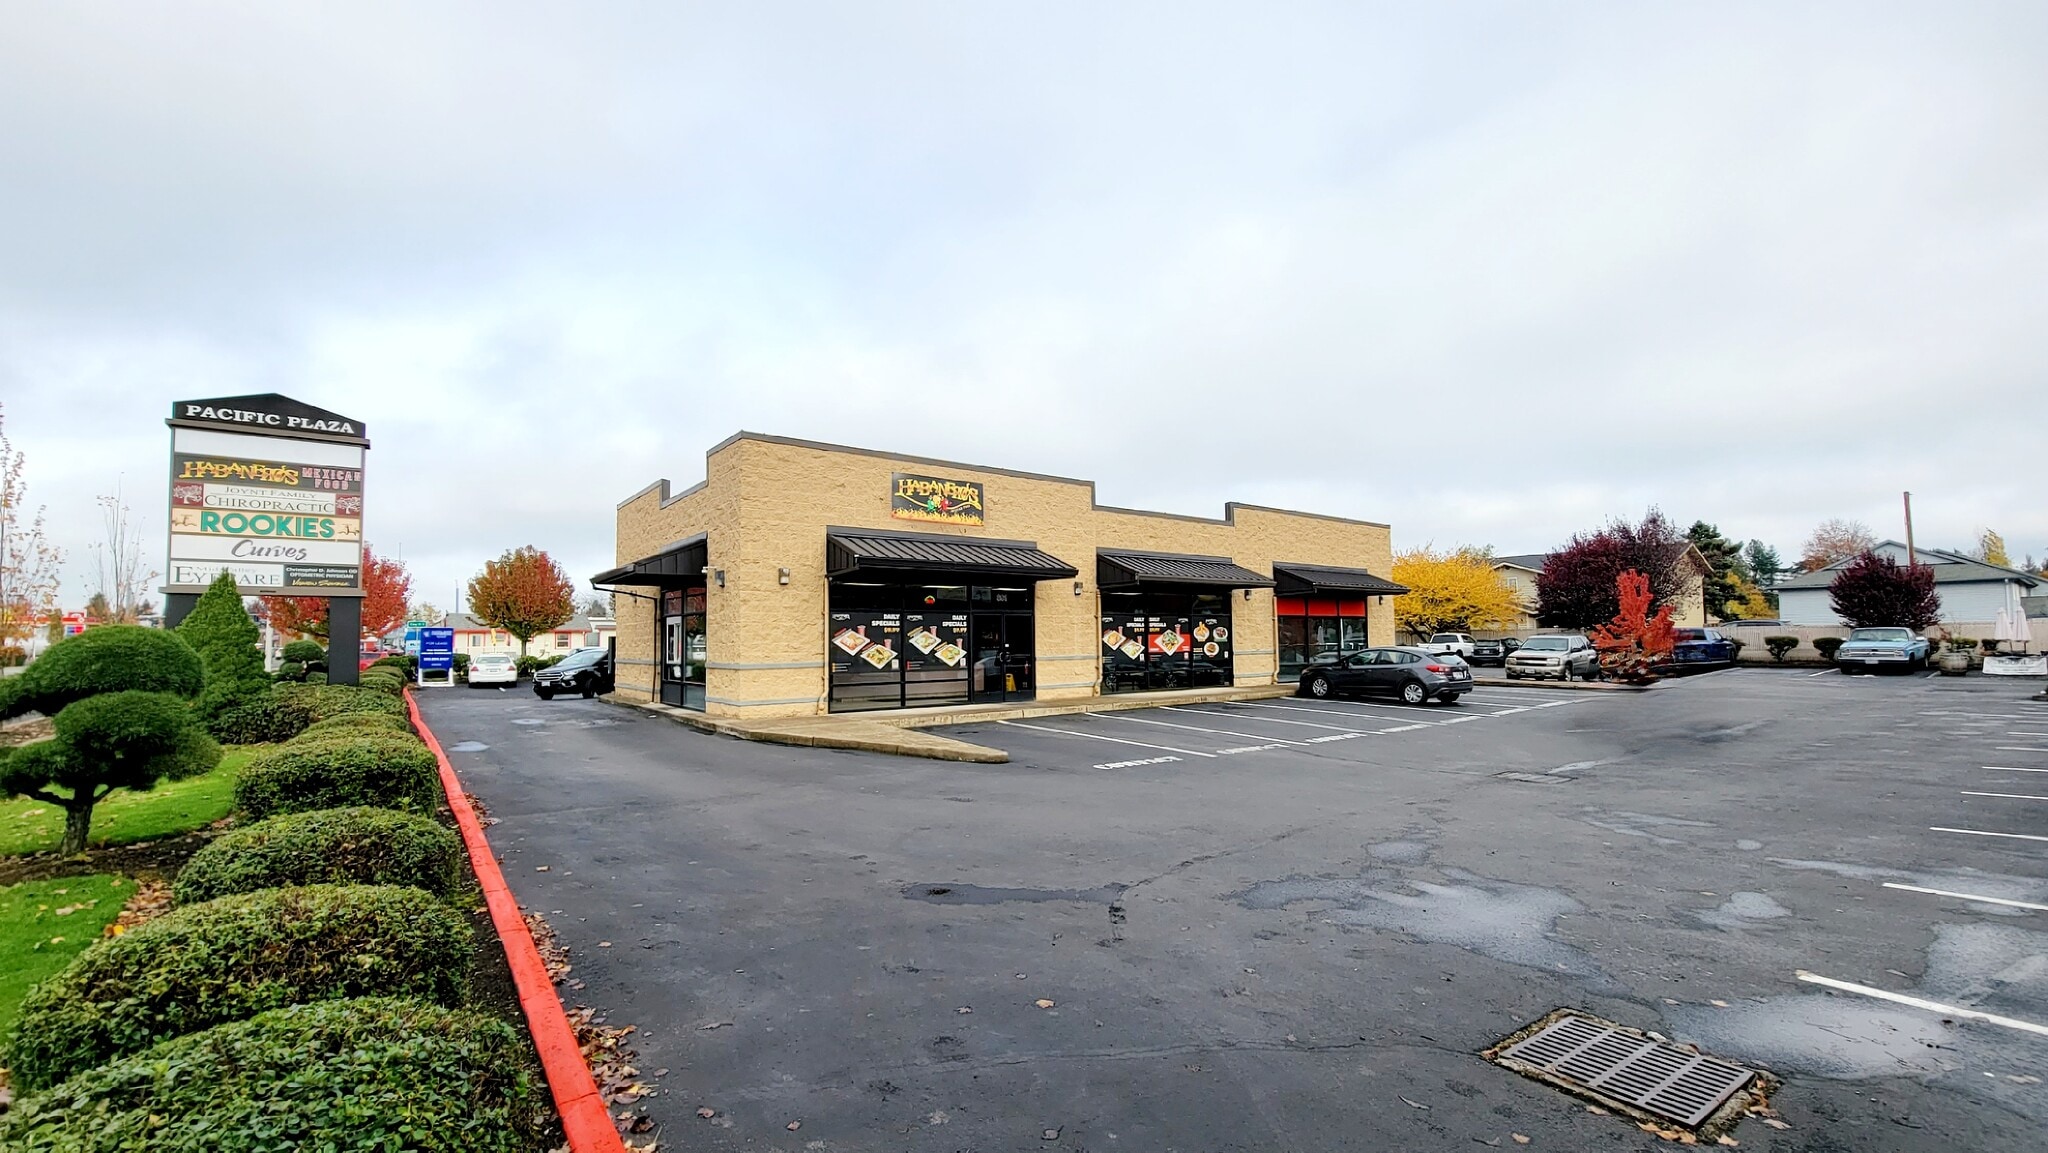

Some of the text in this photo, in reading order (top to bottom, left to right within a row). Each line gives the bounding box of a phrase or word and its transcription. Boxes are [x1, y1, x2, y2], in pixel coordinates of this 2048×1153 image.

[185, 404, 355, 434] PACIFIC PLAZA
[302, 467, 361, 482] MEXICAN
[314, 478, 349, 490] FOOD
[225, 486, 317, 499] JOYNT FAMILY
[204, 495, 335, 513] CHIROPRACTIC
[200, 511, 336, 538] ROOKIES
[231, 539, 307, 560] Curves
[173, 565, 281, 586] EYEARE
